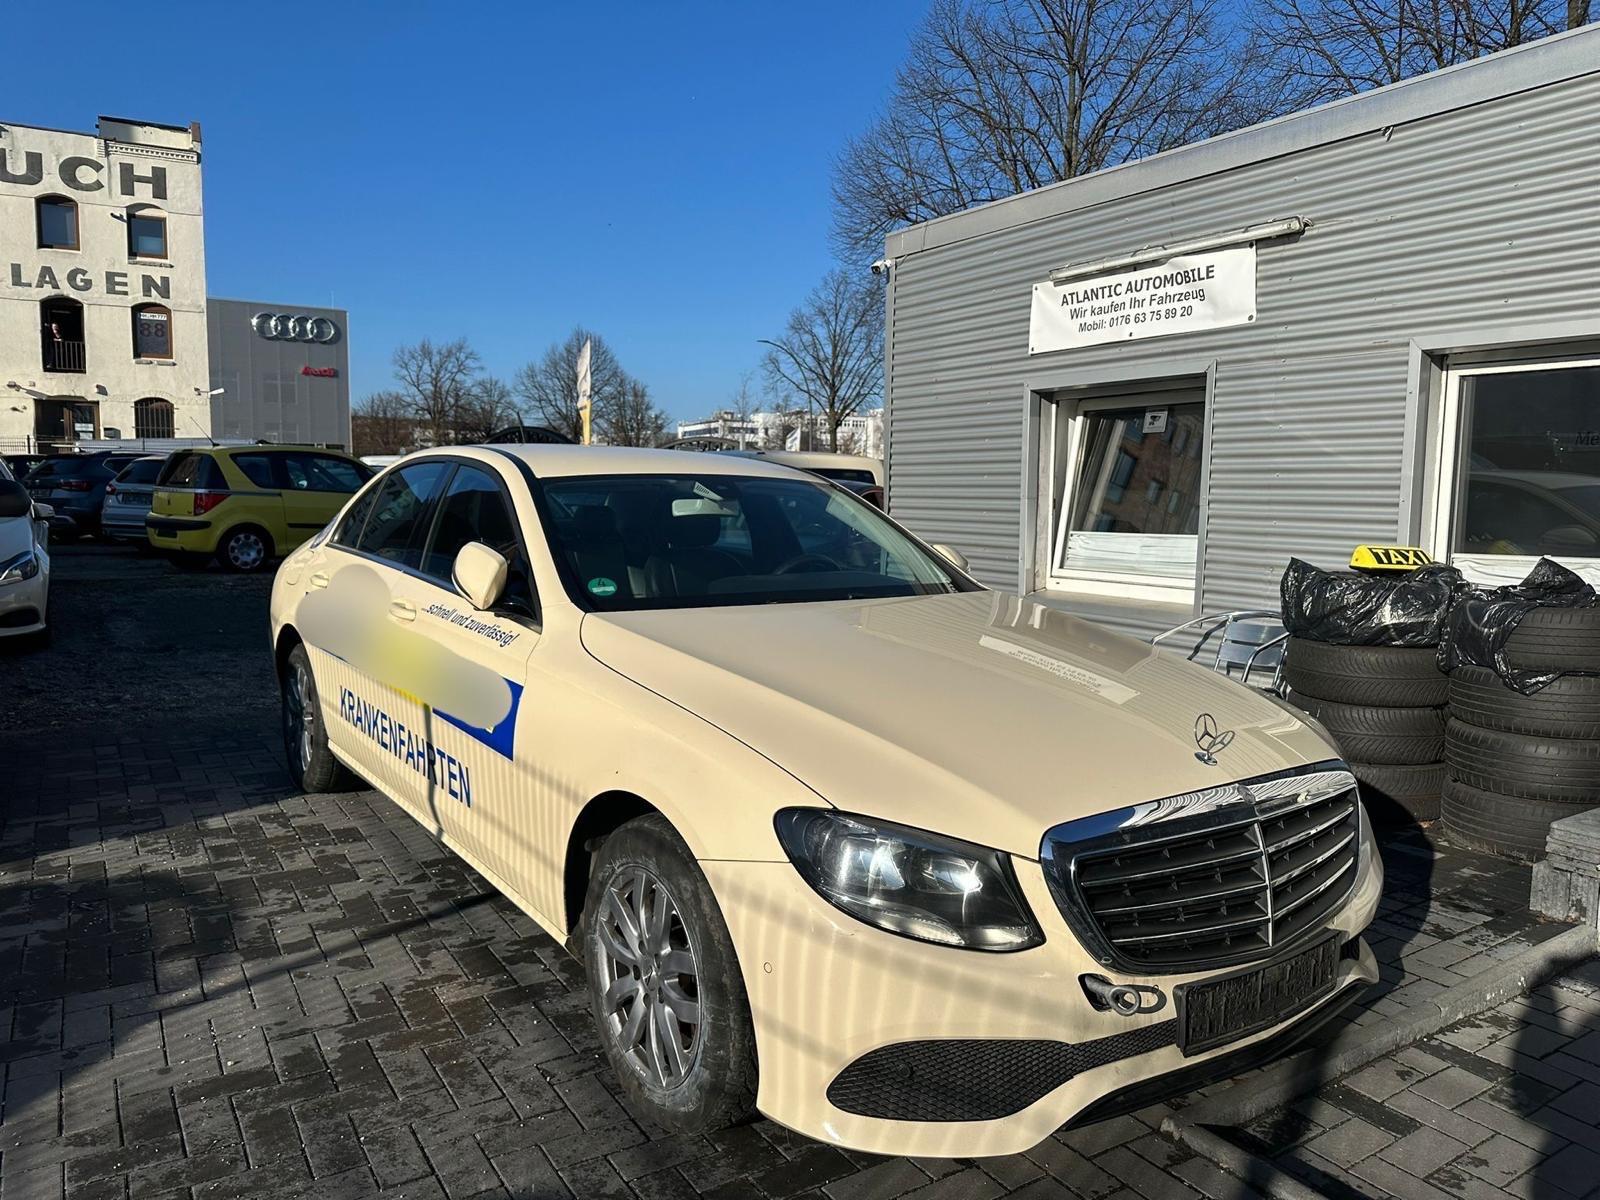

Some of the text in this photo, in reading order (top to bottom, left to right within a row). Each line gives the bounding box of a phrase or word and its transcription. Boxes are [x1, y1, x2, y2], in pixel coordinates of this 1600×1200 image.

[0, 149, 167, 200] UCH
[11, 262, 170, 299] LAGEN
[1061, 264, 1215, 307] ATLANTIC AUTOMOBILE
[1069, 288, 1206, 320] Wir kaufen Ihr Fahrzeug
[1078, 305, 1193, 333] Mobil: 0176 63 75 89 20
[1371, 548, 1430, 566] TAXI
[450, 612, 473, 627] und
[464, 619, 520, 647] zuverlässig!
[339, 685, 472, 808] KRANKENFAHRTEN
